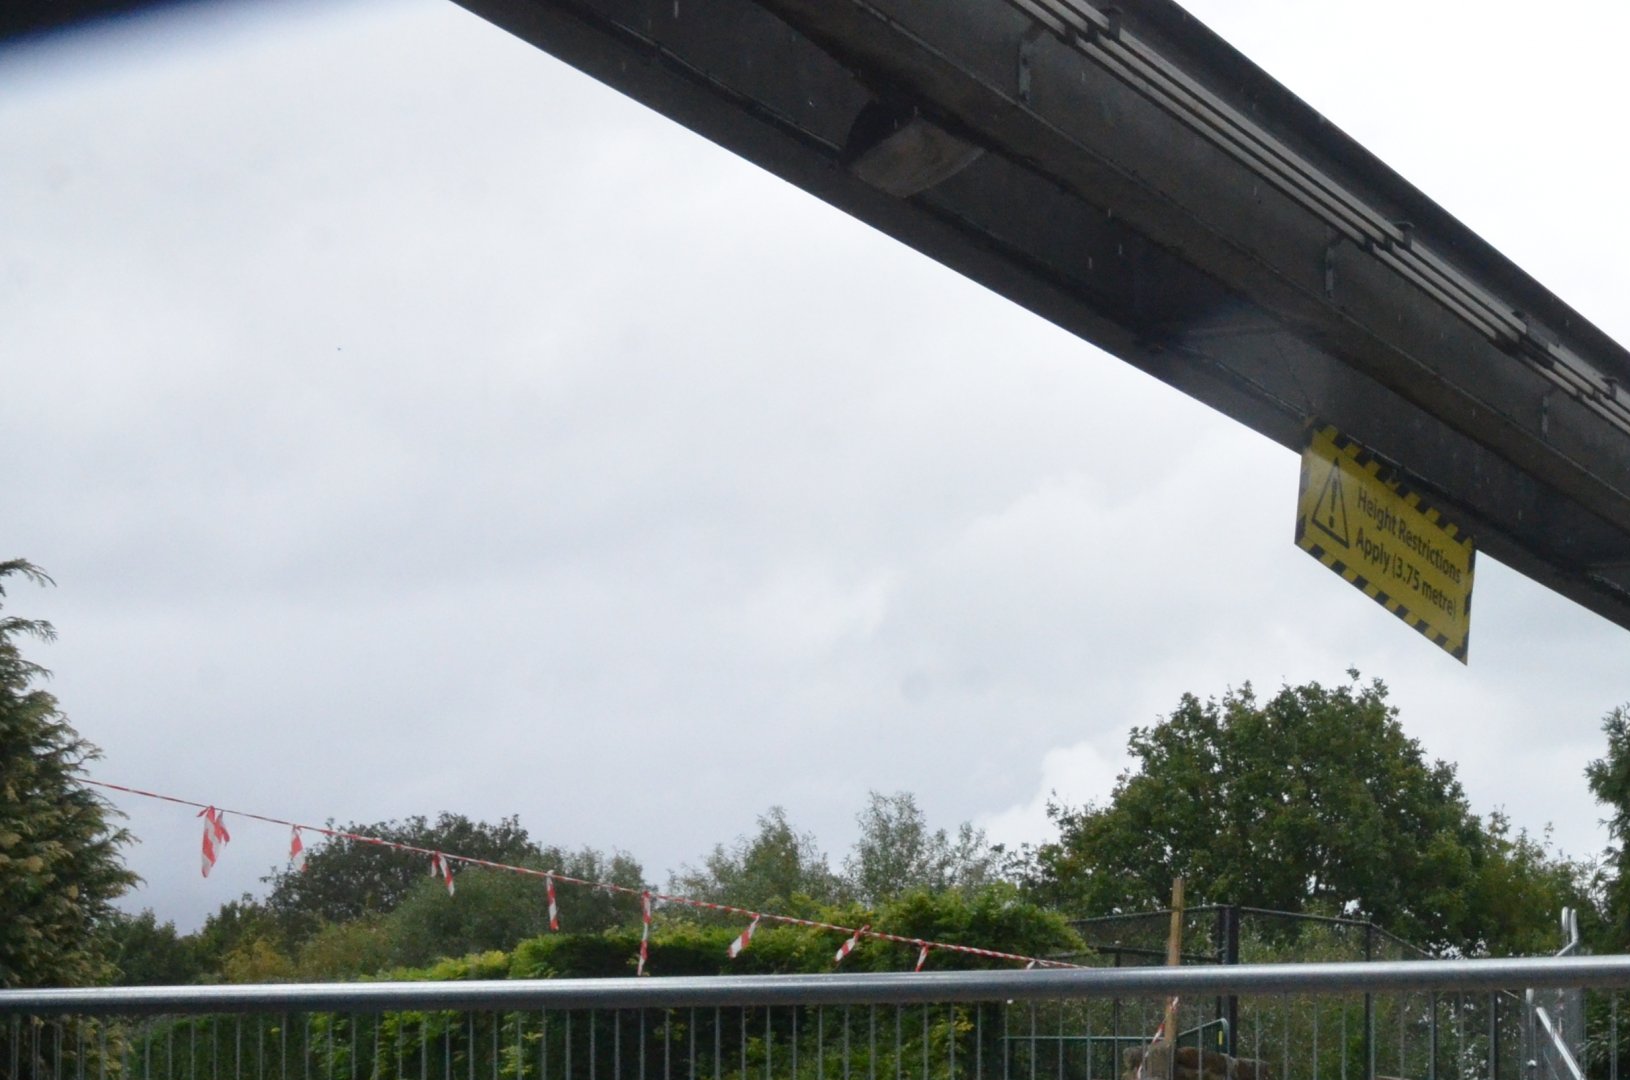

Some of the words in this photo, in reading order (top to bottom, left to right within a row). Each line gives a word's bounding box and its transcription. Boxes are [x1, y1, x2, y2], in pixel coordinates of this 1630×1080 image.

[1356, 528, 1391, 574] Apply
[1392, 553, 1420, 592] (3.75
[1358, 487, 1397, 536] Height
[1400, 519, 1461, 584] Restrictions
